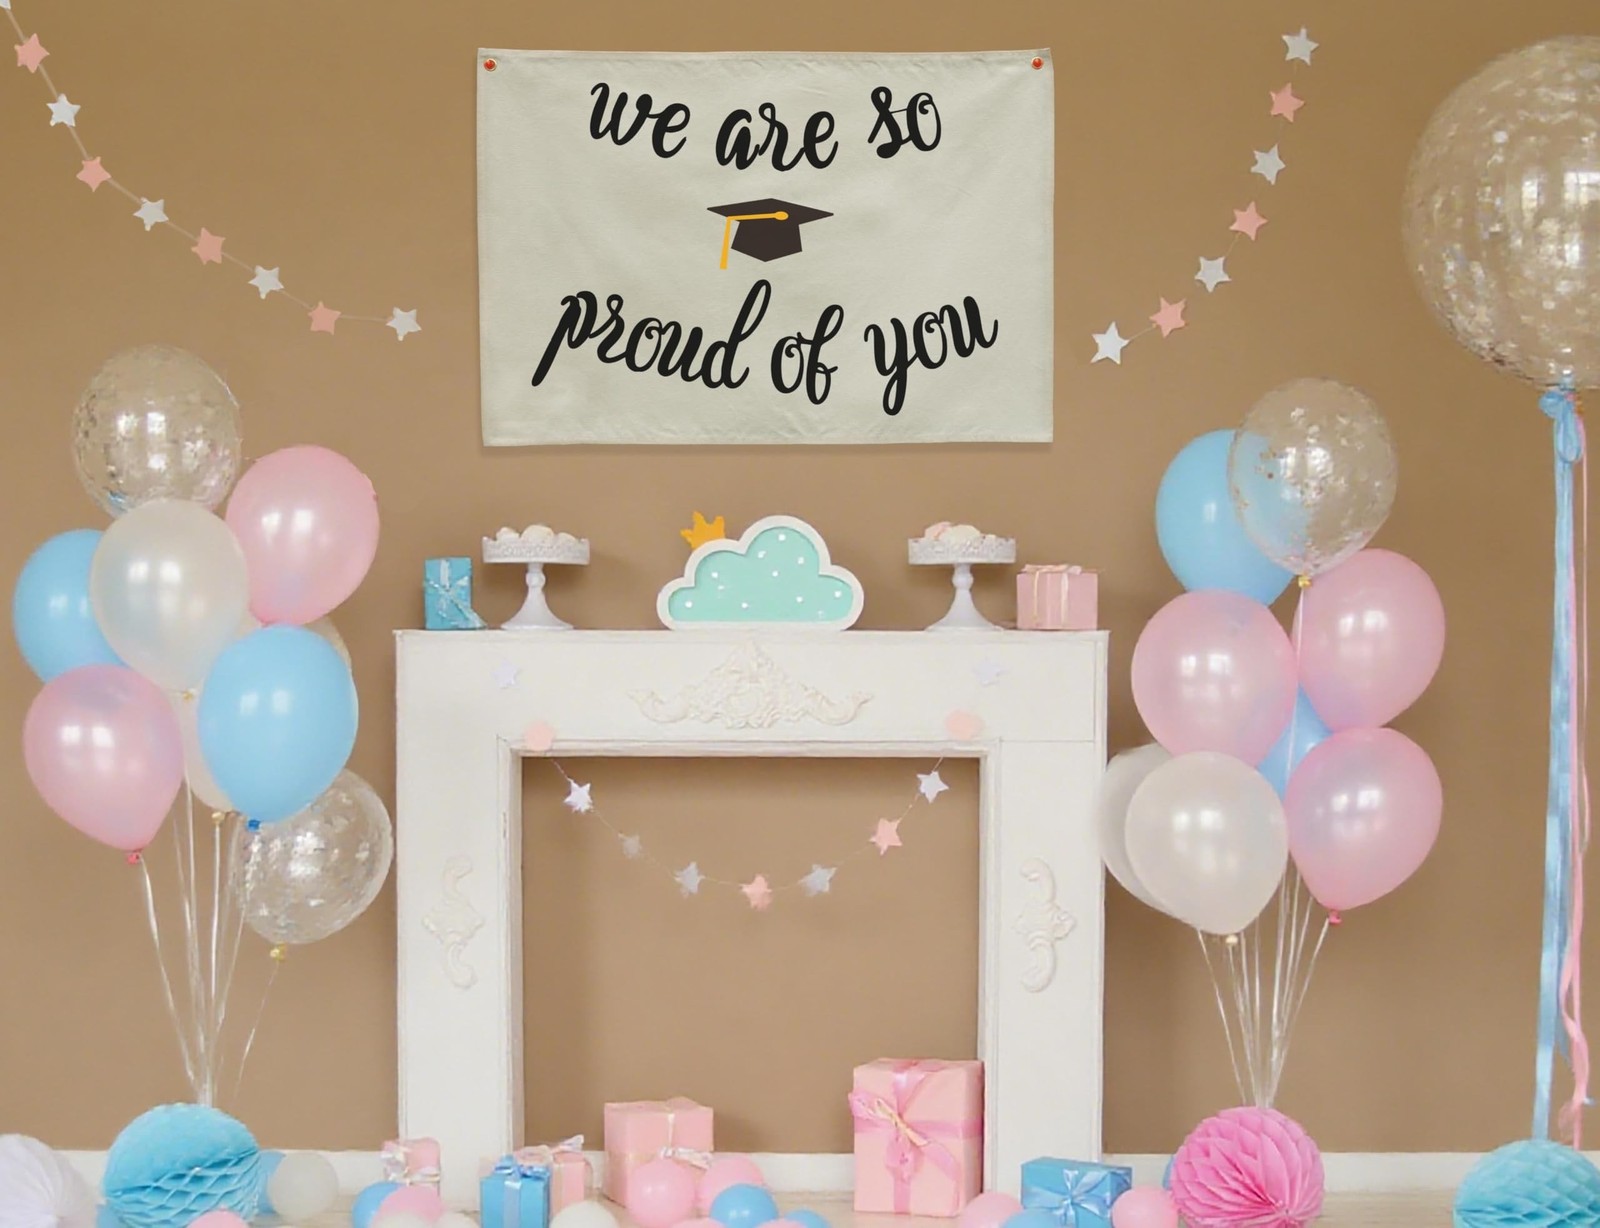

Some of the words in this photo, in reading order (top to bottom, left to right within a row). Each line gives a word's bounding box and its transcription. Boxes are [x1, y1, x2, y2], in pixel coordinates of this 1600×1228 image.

[590, 82, 691, 158] we
[715, 102, 838, 172] are
[867, 86, 942, 159] so
[531, 279, 771, 389] proud
[770, 304, 845, 405] of
[863, 295, 999, 416] you
